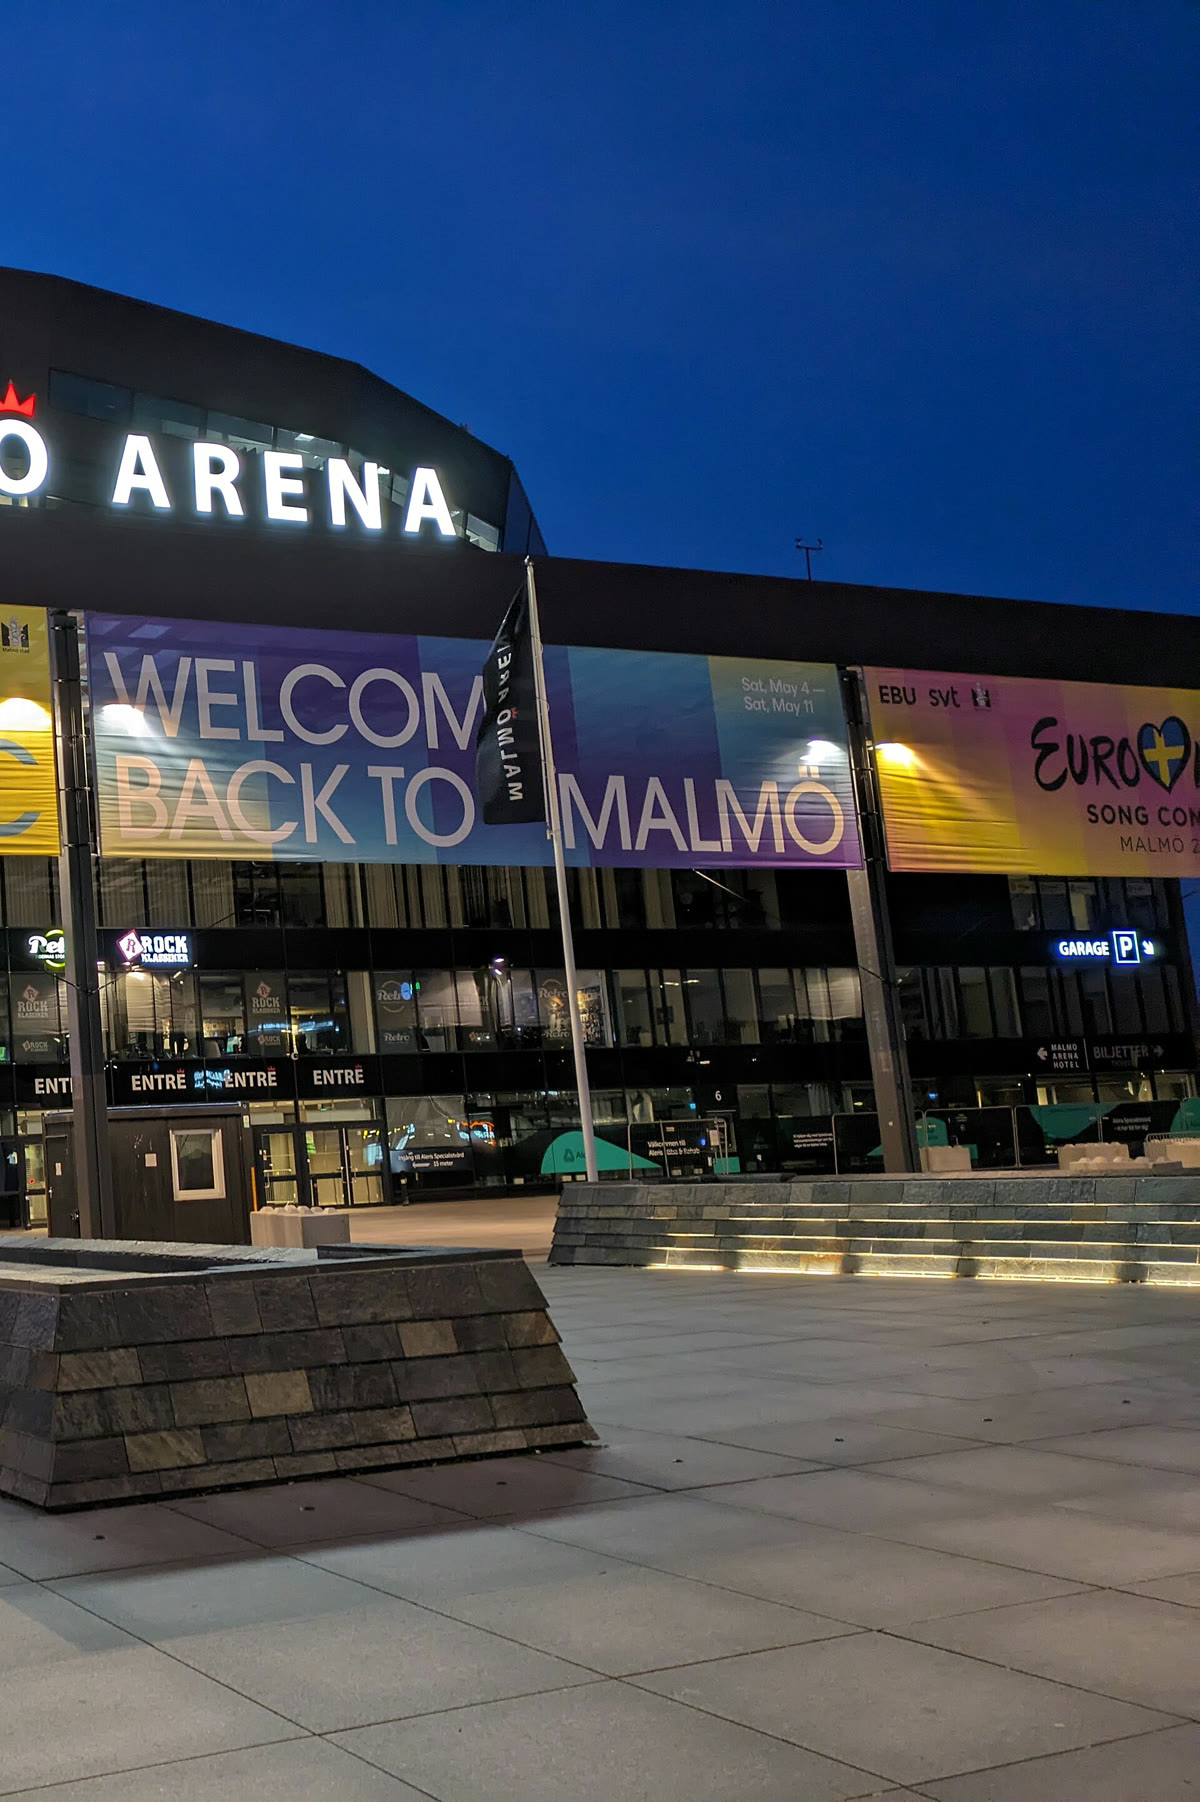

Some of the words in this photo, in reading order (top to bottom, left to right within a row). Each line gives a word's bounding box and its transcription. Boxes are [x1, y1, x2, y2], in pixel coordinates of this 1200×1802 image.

[112, 434, 457, 536] ARENA
[741, 677, 767, 694] Sat,
[769, 679, 798, 698] May
[879, 685, 916, 705] EBU
[928, 686, 961, 708] svt
[104, 651, 488, 751] WELCOM
[744, 696, 770, 712] Sat,
[773, 698, 801, 716] May
[804, 700, 814, 713] 11
[115, 754, 356, 845] BACK
[368, 766, 476, 847] TO
[558, 764, 845, 856] MALMÖ
[1087, 804, 1149, 826] SONG
[1120, 834, 1184, 854] MALMÖ
[140, 935, 188, 954] ROCK
[1059, 941, 1109, 956] GARAGE
[17, 1000, 48, 1012] ROCK
[252, 997, 280, 1008] ROCK
[1052, 1052, 1079, 1060] ARENA
[1053, 1060, 1080, 1069] HOTEL
[34, 1077, 73, 1095] ENT
[714, 1090, 722, 1101] 6
